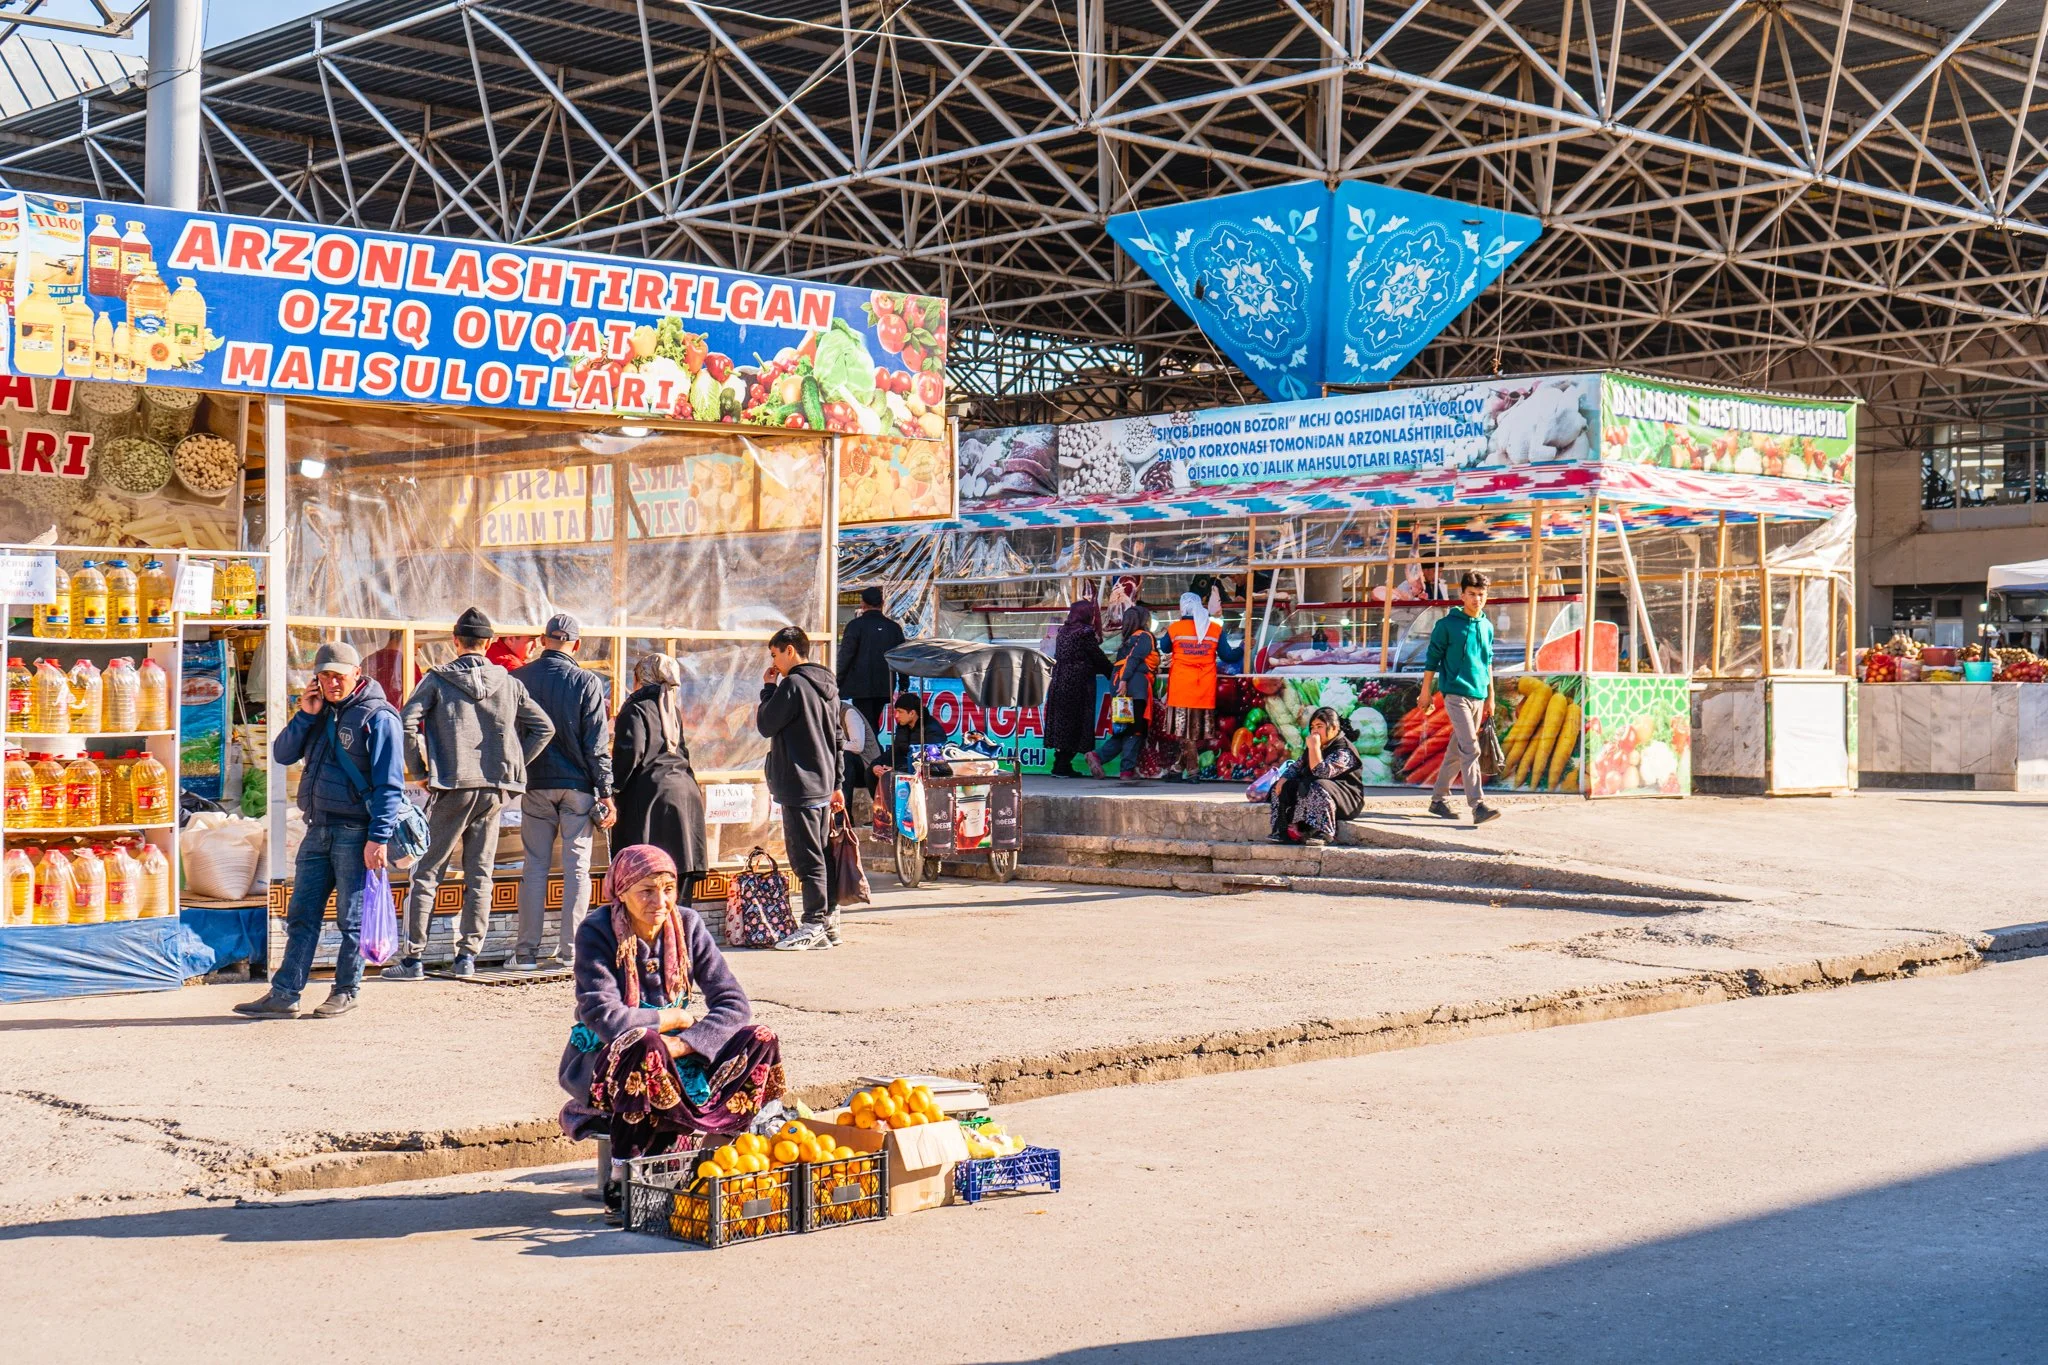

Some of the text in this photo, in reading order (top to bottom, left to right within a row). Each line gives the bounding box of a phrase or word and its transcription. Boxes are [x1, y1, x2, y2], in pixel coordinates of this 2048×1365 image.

[174, 224, 832, 333] ARZONLASHTIRILGAN
[281, 292, 634, 358] OZIQ OVQAT
[225, 344, 677, 413] MAHSULOTLARI
[1192, 421, 1241, 438] DEHQON
[1299, 412, 1331, 428] MCHJ
[1334, 405, 1405, 425] QOSHIDAGI
[1409, 398, 1485, 419] TAYYORLOV
[1158, 446, 1196, 462] SAVDO
[1200, 440, 1267, 458] KORXONASI
[1188, 465, 1239, 480] QISHLOQ
[1297, 452, 1390, 471] MAHSULOTLARI
[1393, 448, 1444, 465] RASTASI
